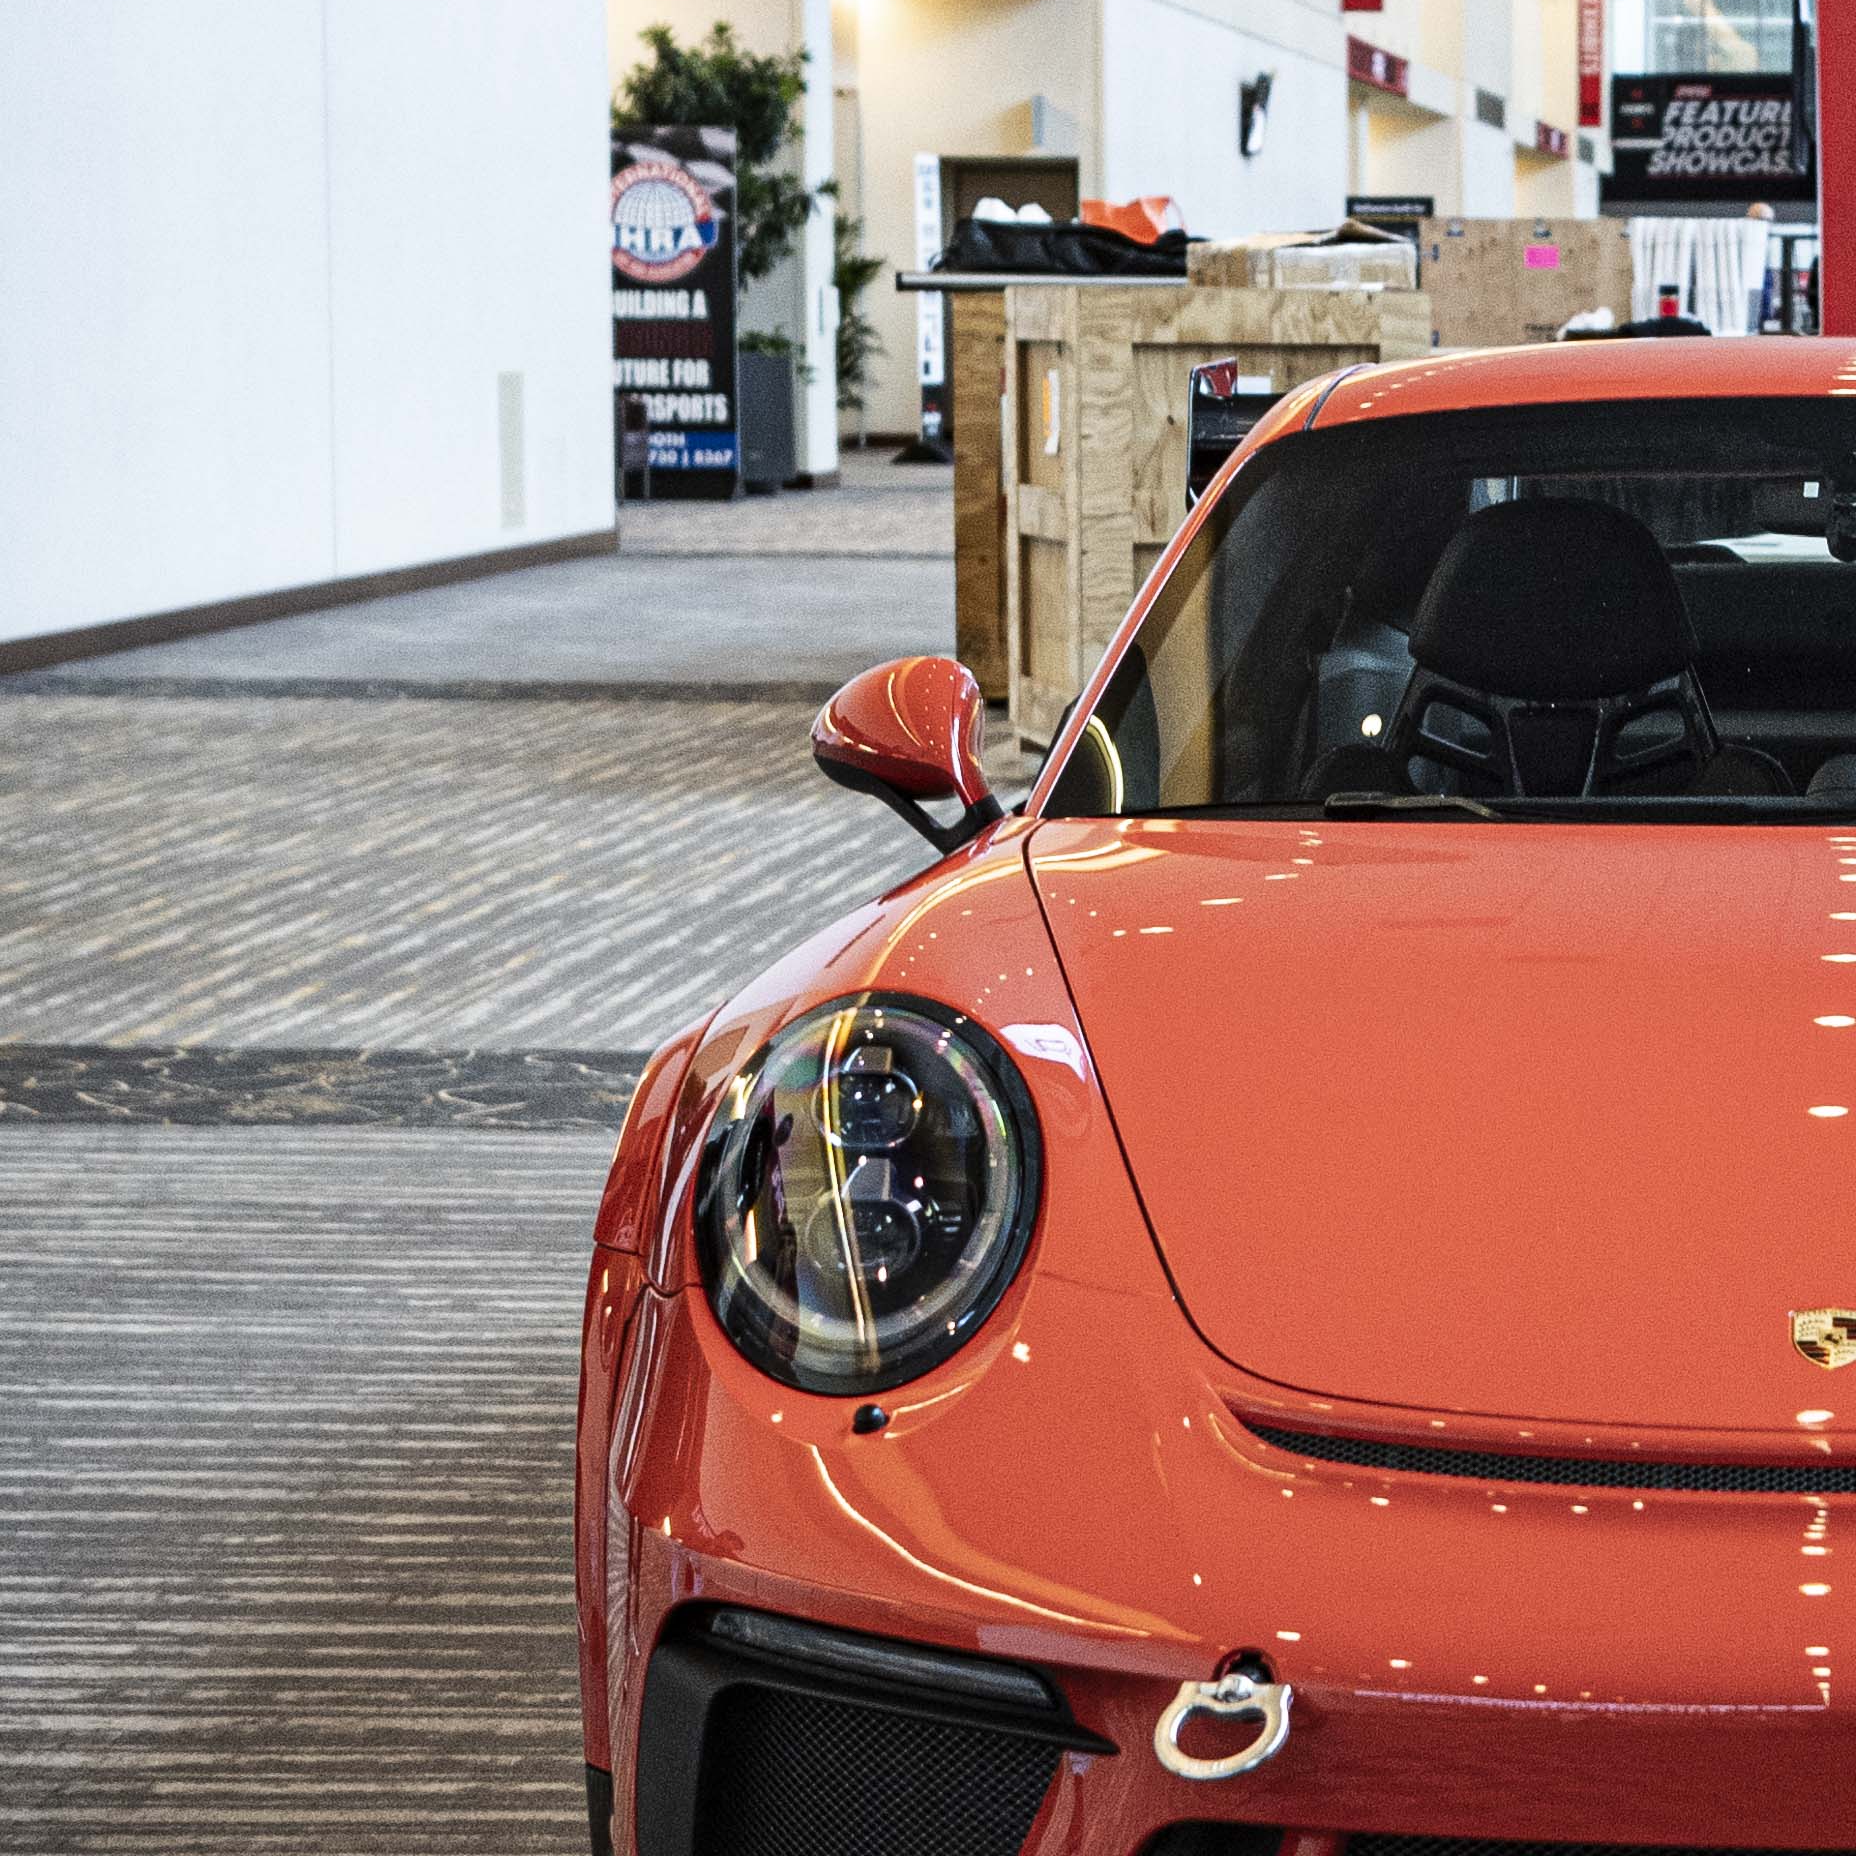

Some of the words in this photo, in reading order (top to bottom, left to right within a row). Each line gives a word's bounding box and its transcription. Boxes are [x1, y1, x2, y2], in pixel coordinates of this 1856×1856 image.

[1648, 149, 1793, 175] SHOWCAS
[612, 288, 689, 318] UILDING
[692, 288, 708, 318] A
[672, 358, 710, 387] FOR
